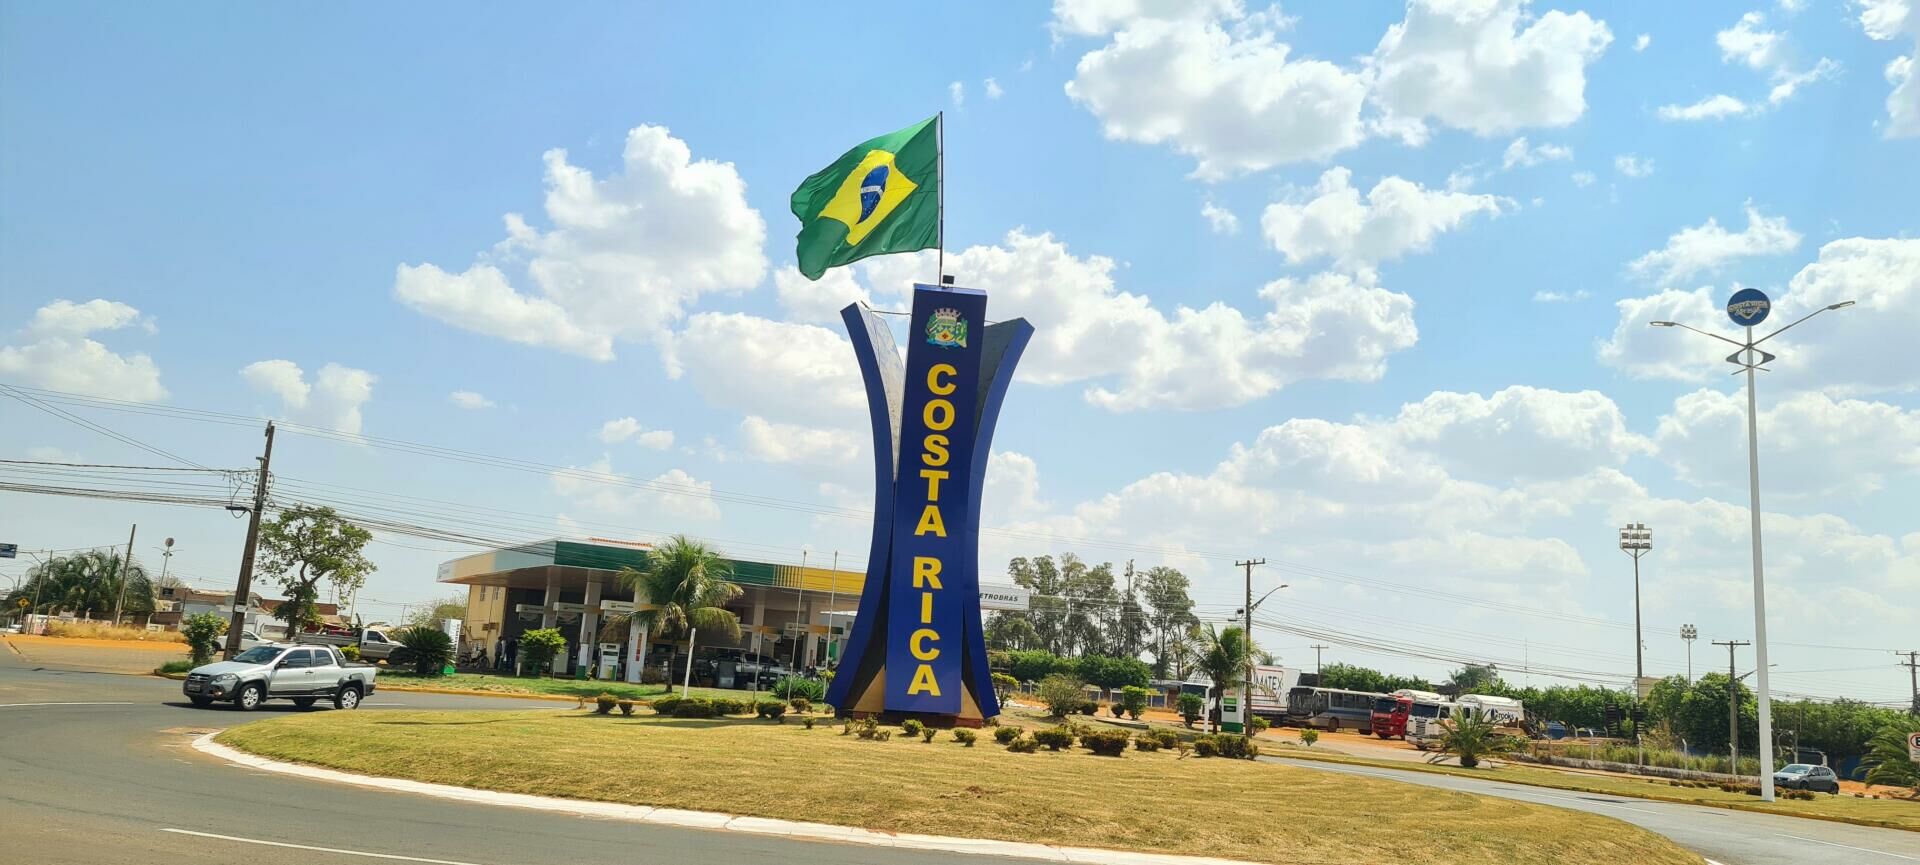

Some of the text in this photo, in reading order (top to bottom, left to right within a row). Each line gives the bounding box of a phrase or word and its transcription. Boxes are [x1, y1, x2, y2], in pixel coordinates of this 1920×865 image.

[907, 363, 957, 697] COSTA RICA
[979, 592, 1018, 602] ETROBRAS
